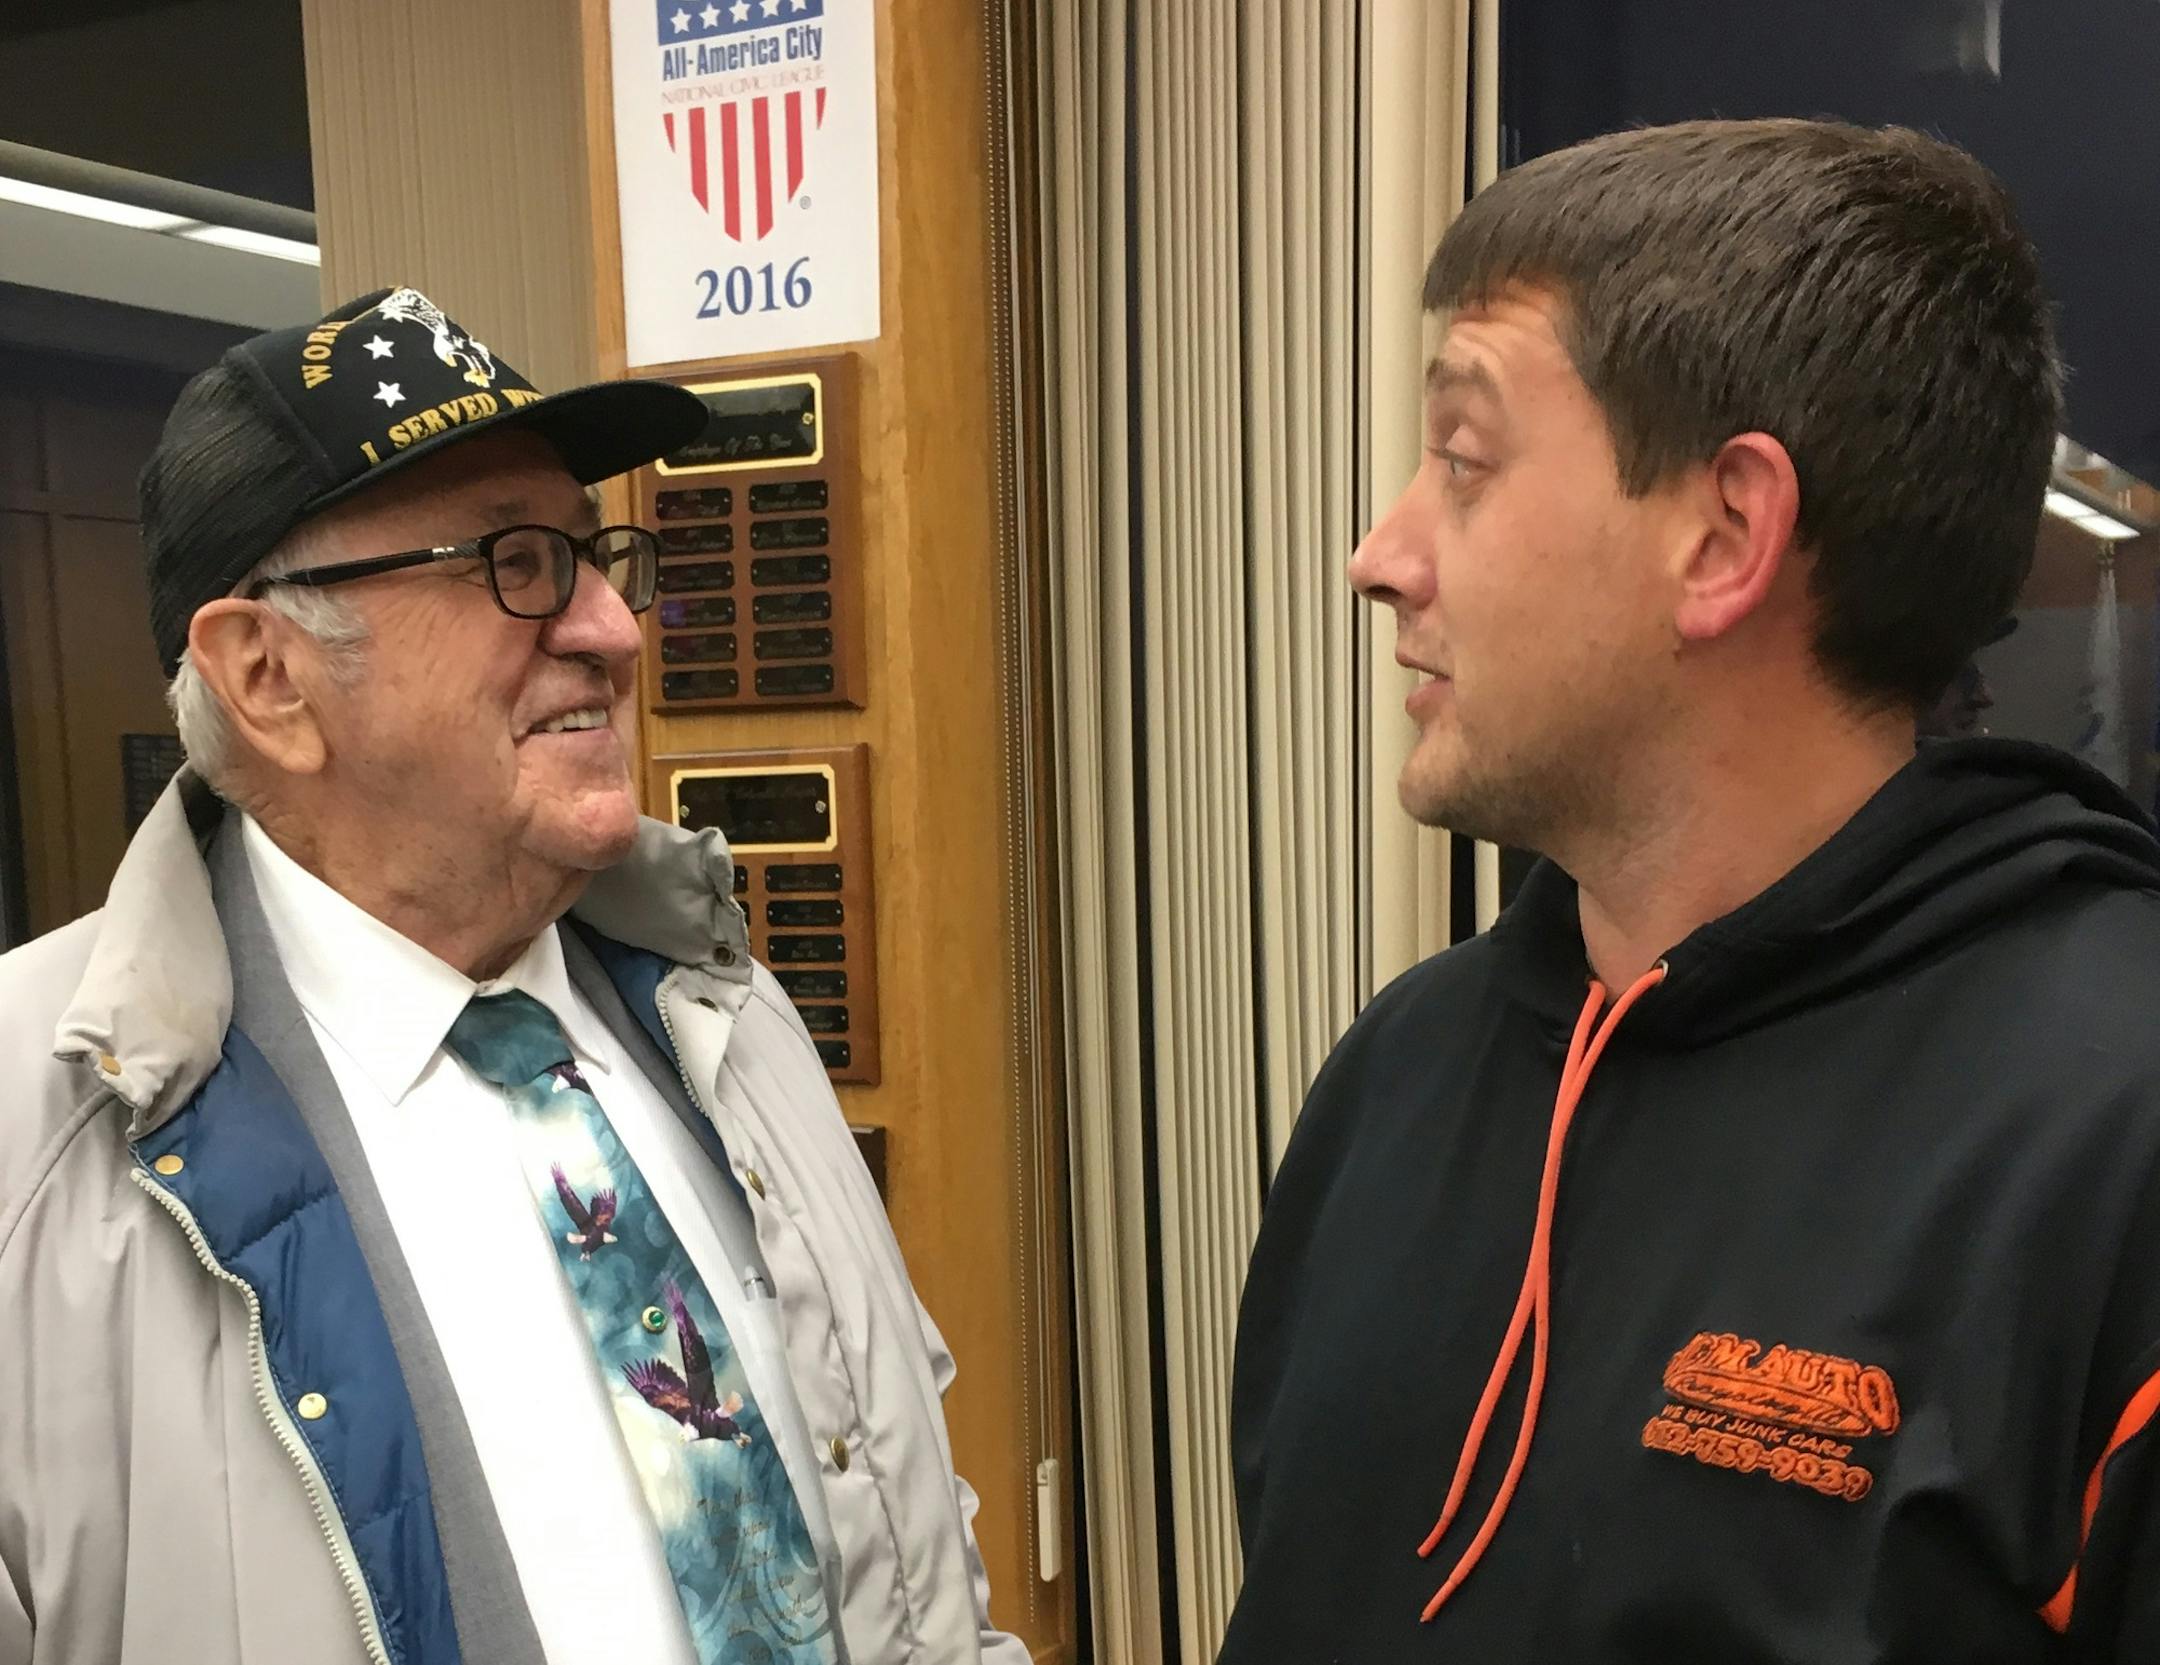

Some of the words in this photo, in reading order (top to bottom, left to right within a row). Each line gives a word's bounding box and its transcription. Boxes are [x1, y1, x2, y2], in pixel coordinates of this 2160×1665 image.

[786, 24, 822, 61] City
[661, 80, 725, 104] NATIONAL
[772, 65, 825, 87] LEAGUE
[695, 256, 812, 319] 2016
[360, 440, 381, 465] I
[388, 392, 499, 449] SERVED
[1751, 1344, 1901, 1435] AUTO
[1661, 1404, 1685, 1419] WE
[1684, 1408, 1727, 1428] BUY
[1725, 1418, 1790, 1443] JUNK
[1788, 1433, 1853, 1459] CARS
